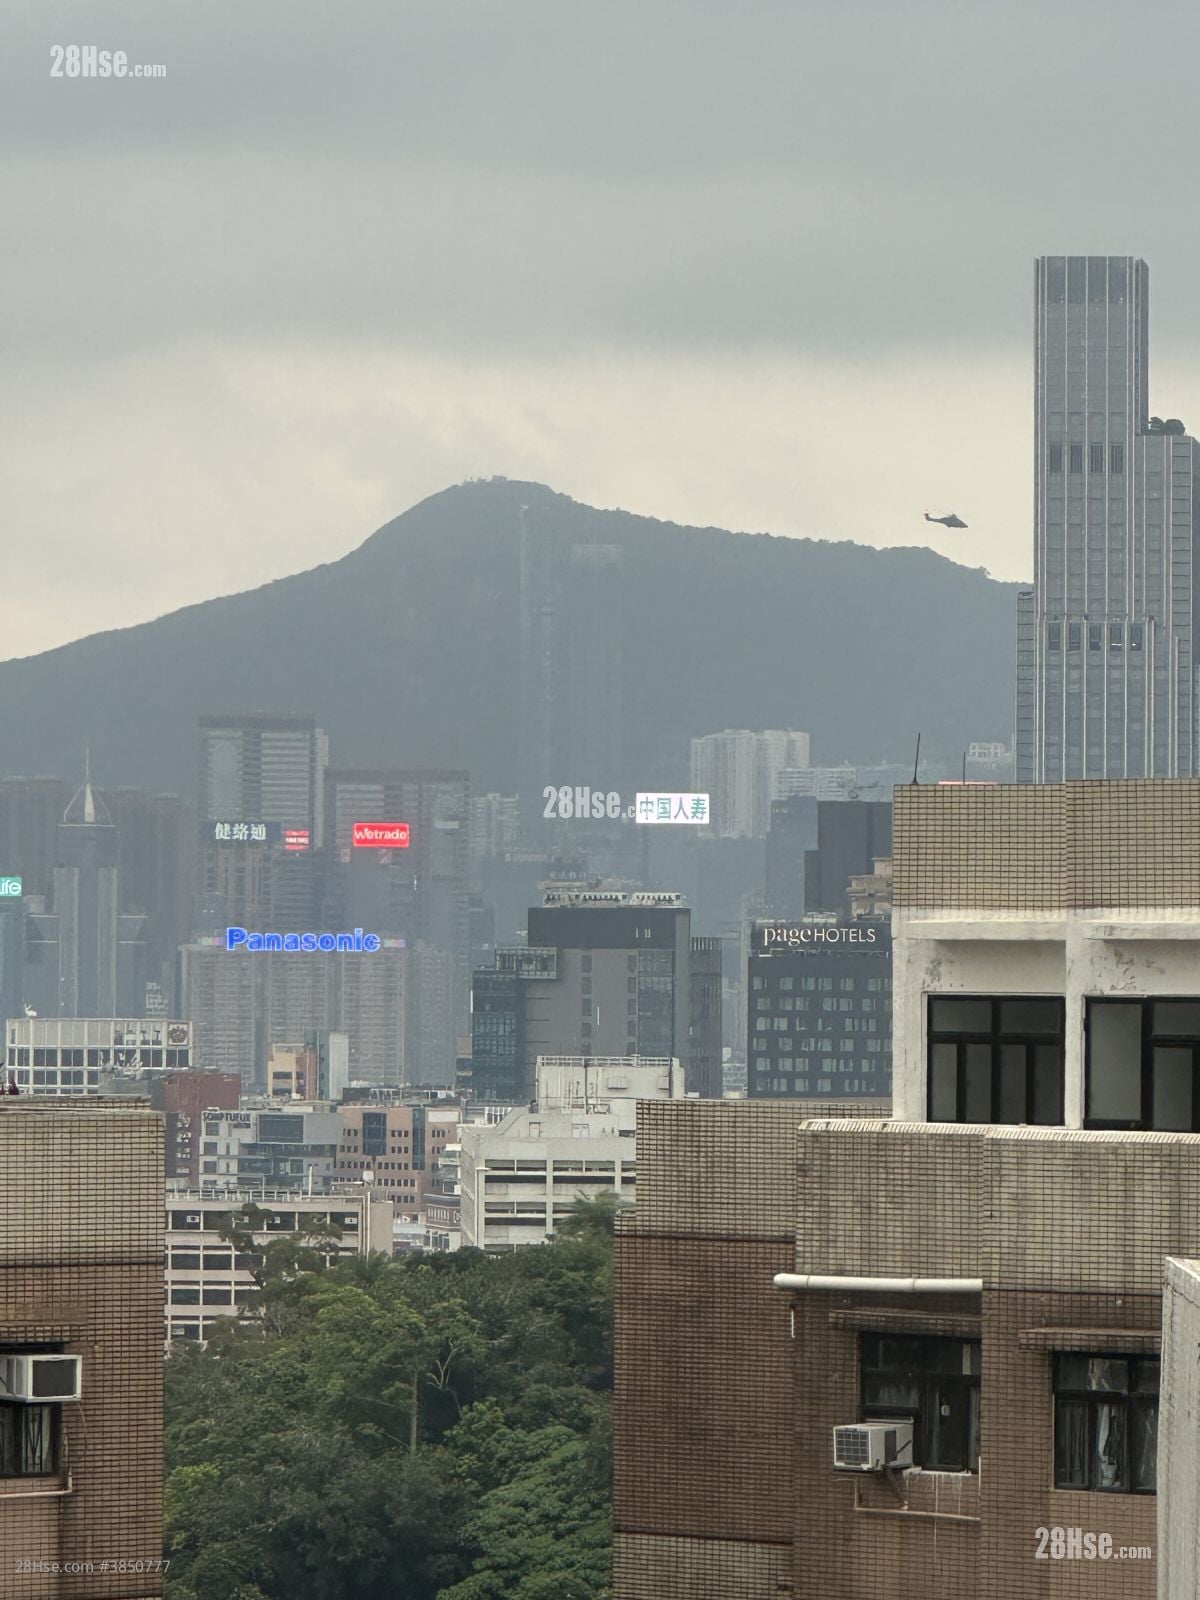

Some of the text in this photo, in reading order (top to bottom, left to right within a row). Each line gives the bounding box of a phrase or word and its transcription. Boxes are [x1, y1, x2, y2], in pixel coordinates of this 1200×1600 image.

[639, 796, 707, 820] 中国人寿
[0, 879, 22, 895] ife
[226, 927, 381, 952] Panasonic
[764, 928, 876, 946] page HOTELS
